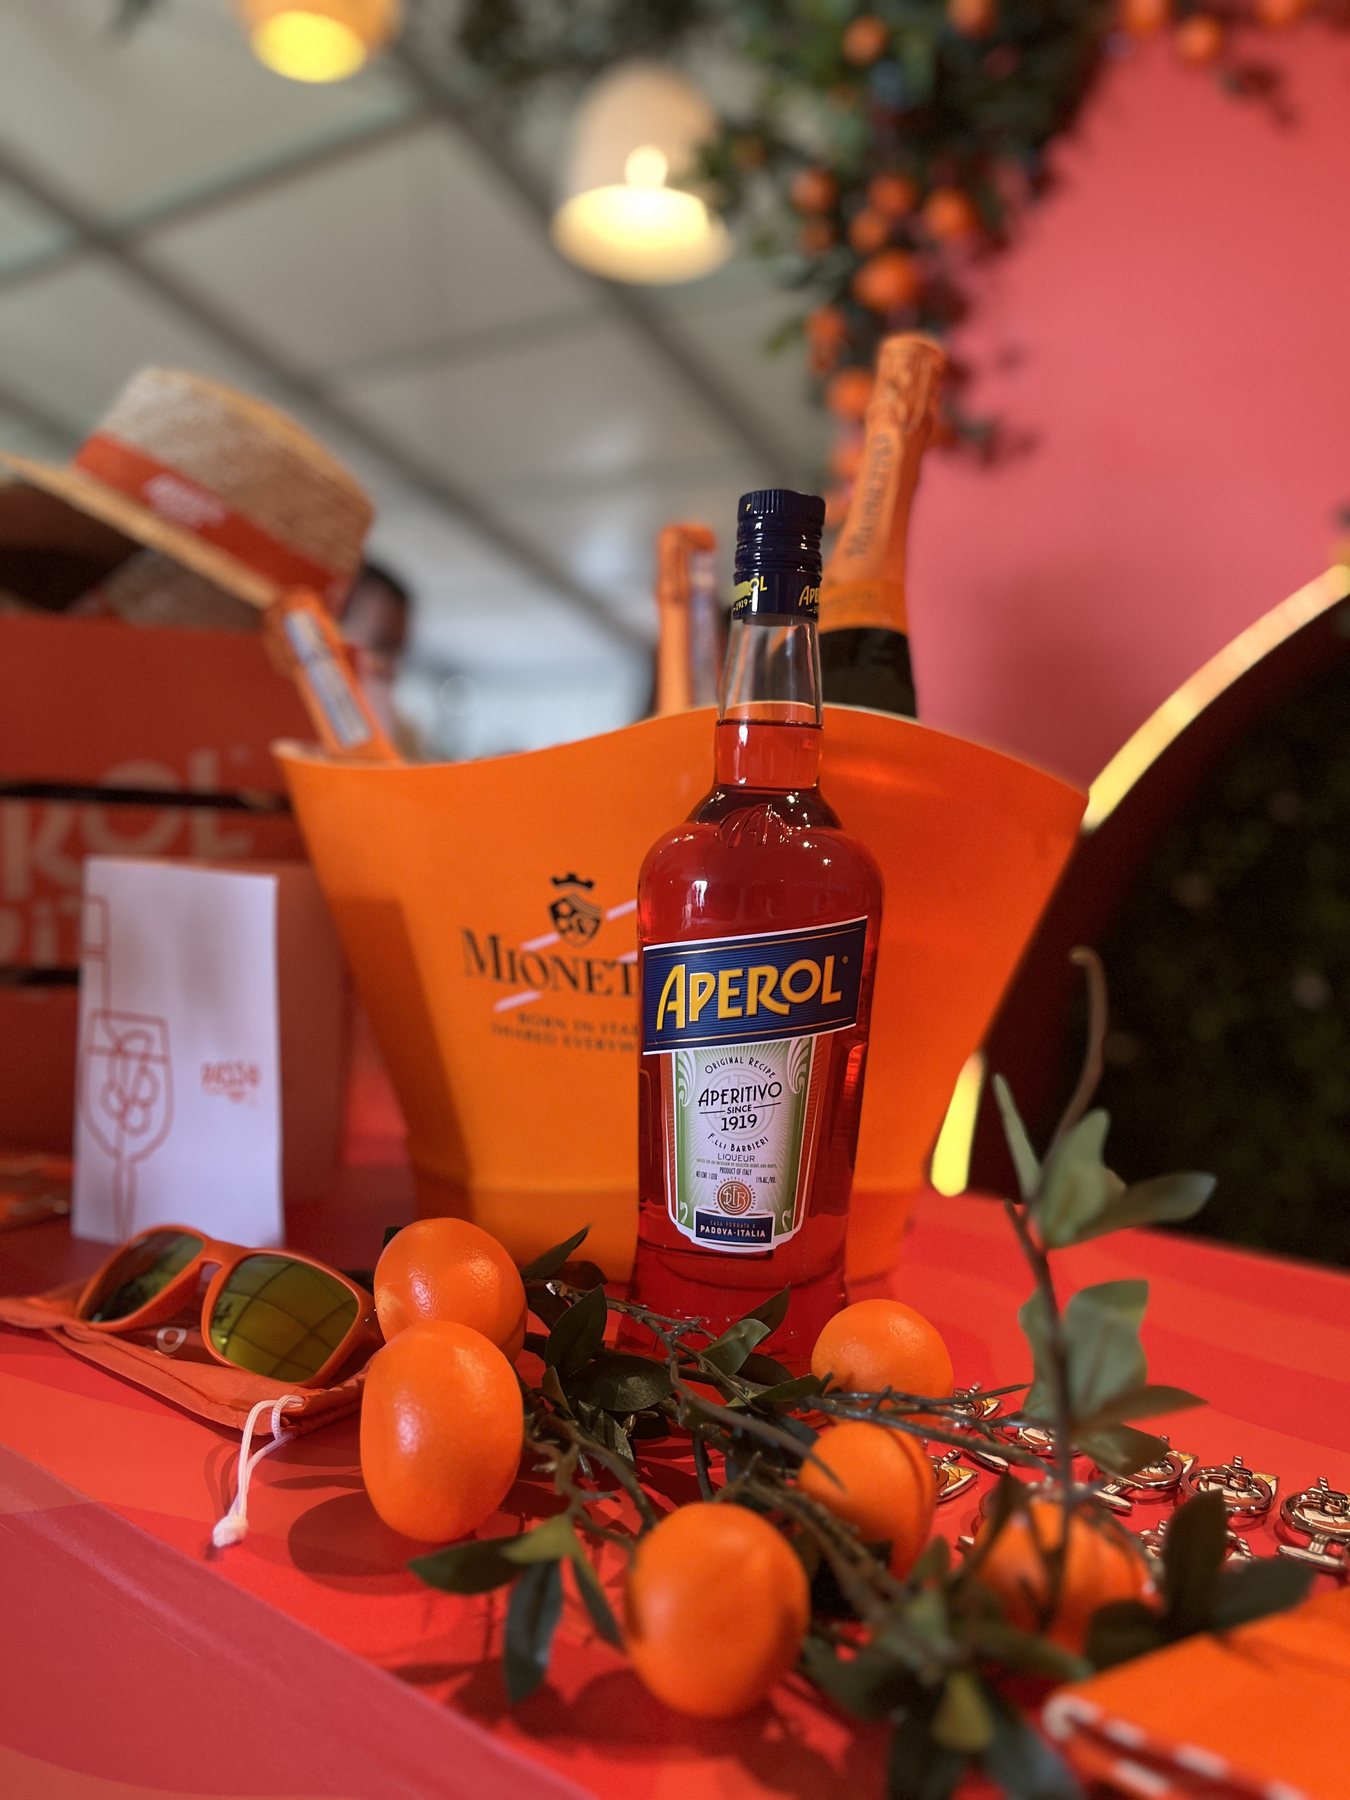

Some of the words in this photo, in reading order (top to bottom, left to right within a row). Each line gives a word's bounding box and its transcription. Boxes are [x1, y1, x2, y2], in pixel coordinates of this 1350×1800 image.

[656, 955, 841, 1031] APEROL
[705, 1057, 743, 1074] ORIGINAL
[749, 1057, 776, 1079] RECIPE
[698, 1082, 782, 1107] APERITIVO
[727, 1105, 752, 1114] SINCE
[721, 1114, 757, 1131] 1919
[730, 1136, 769, 1152] BARBIERI
[717, 1153, 756, 1163] LIQUEUR
